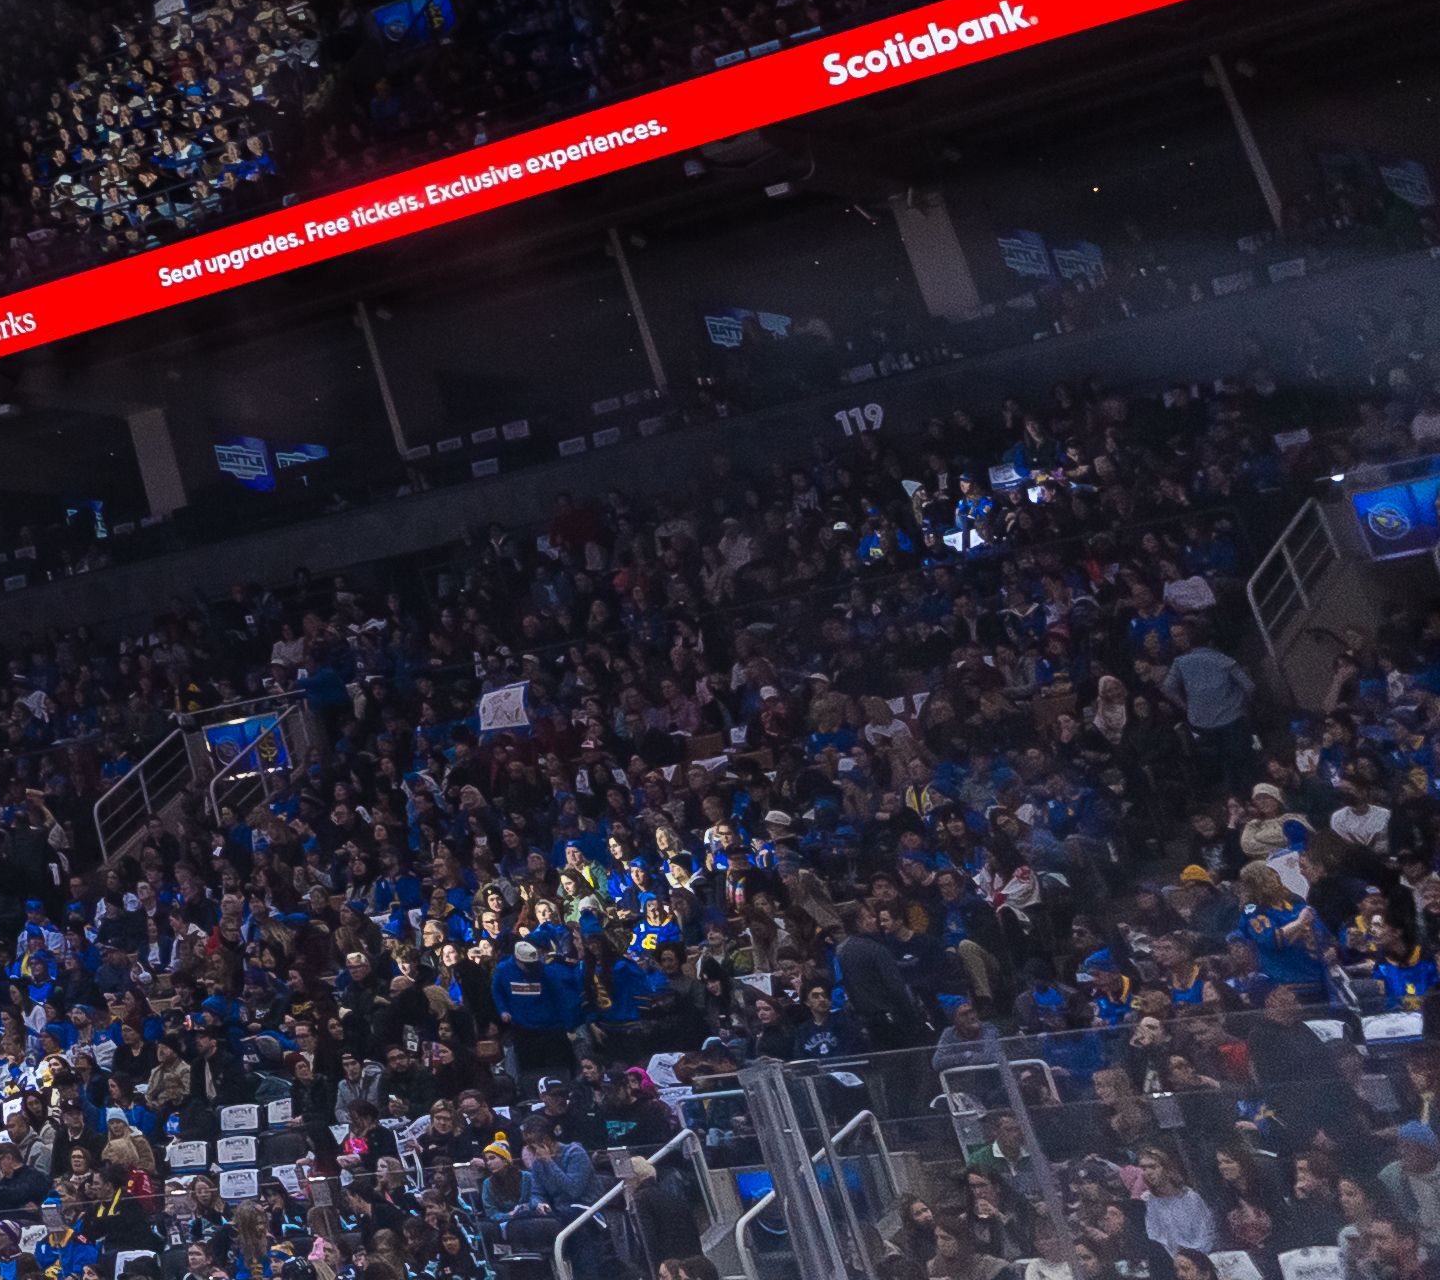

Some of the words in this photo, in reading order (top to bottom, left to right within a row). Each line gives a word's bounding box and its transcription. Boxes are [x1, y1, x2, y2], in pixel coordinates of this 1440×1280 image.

[157, 259, 203, 288] Seat
[204, 229, 305, 276] upgrades.
[305, 214, 350, 244] Free
[351, 192, 426, 229] tickets.
[425, 161, 523, 208] Exclusive
[524, 117, 669, 176] experiences.
[834, 402, 884, 437] 119
[216, 450, 266, 468] BATTLE
